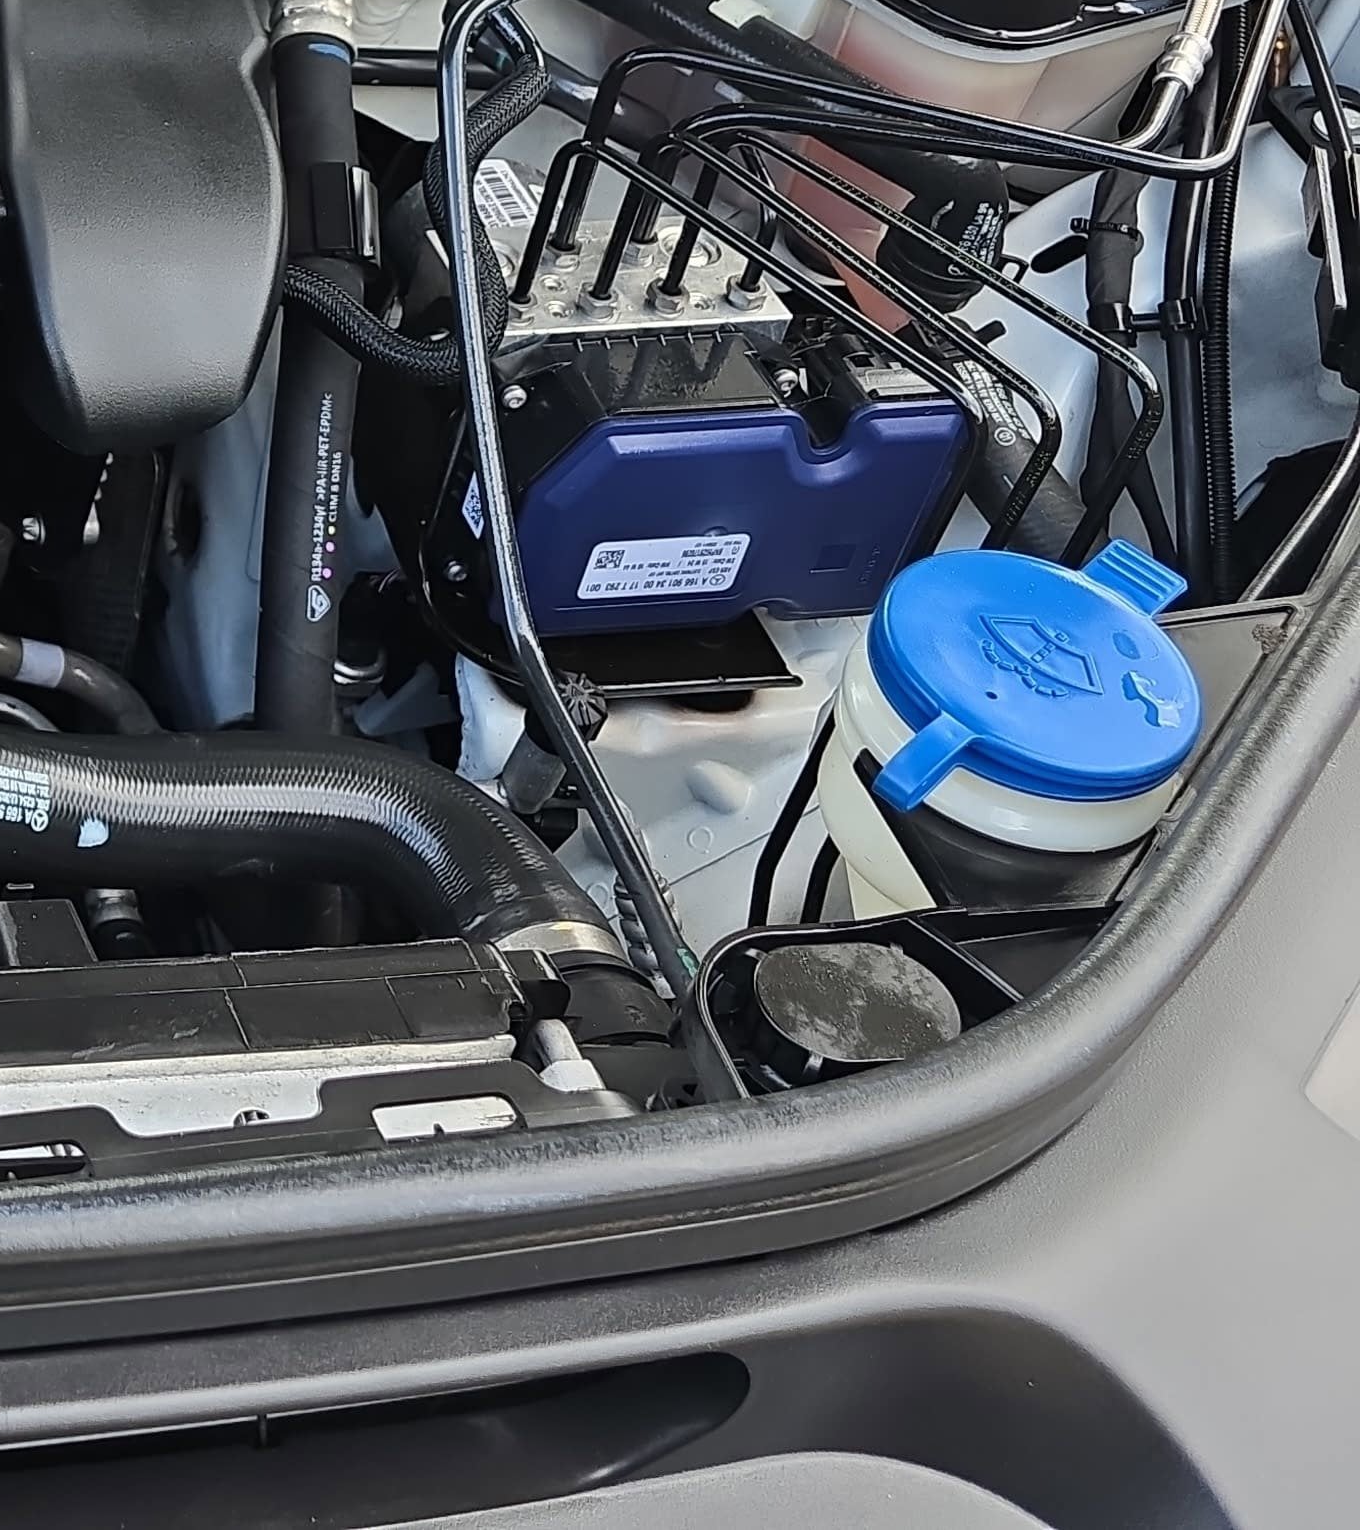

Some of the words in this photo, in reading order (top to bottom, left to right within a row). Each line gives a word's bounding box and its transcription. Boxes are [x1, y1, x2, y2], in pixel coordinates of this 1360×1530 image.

[643, 580, 654, 589] 00
[655, 580, 667, 588] 34
[668, 579, 683, 587] 901
[685, 578, 698, 586] 166
[701, 577, 709, 585] A
[5, 805, 23, 822] 166
[25, 809, 33, 824] A
